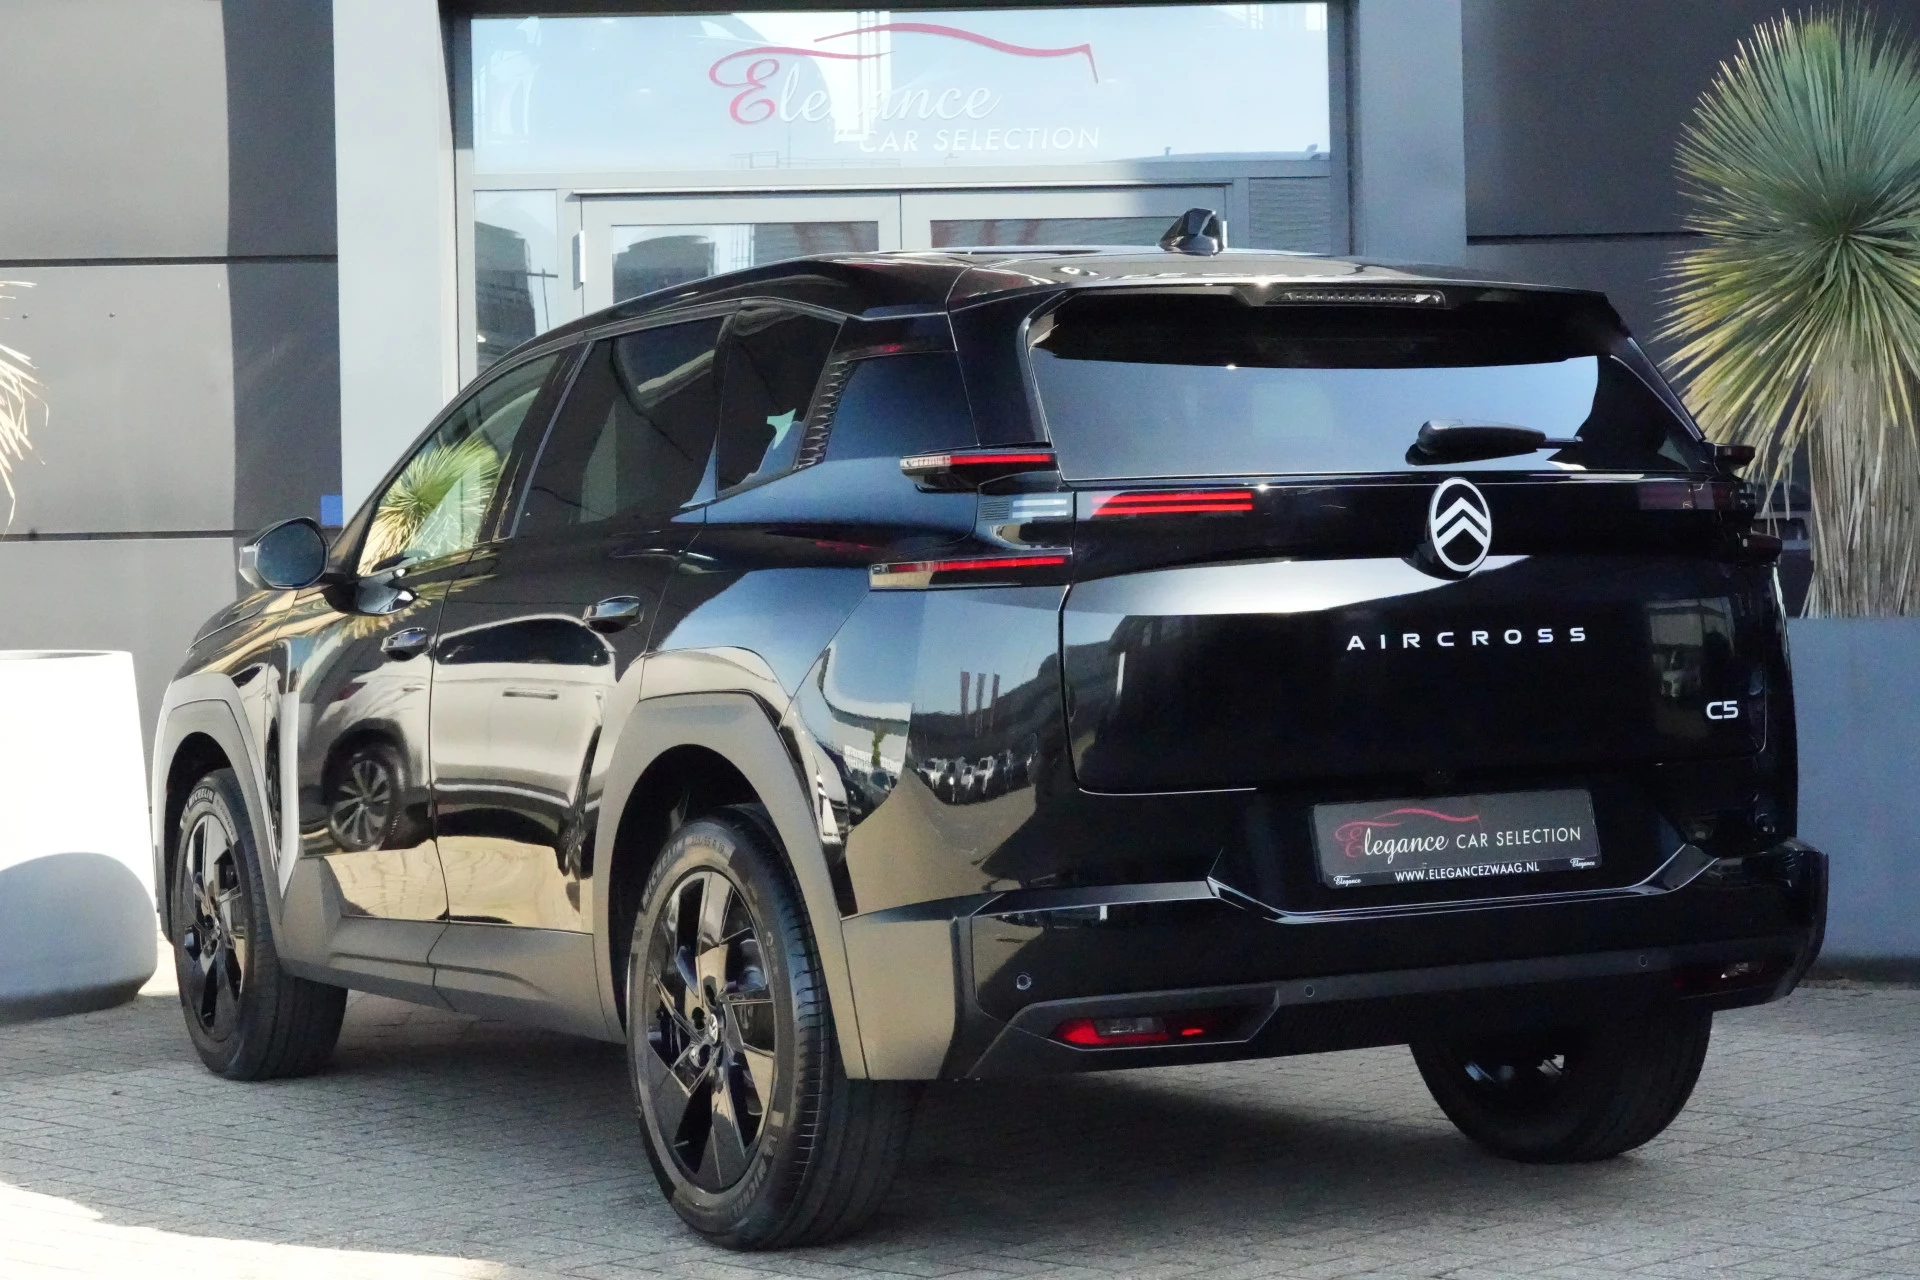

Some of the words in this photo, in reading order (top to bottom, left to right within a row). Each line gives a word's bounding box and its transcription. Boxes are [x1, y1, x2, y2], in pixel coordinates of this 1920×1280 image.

[709, 47, 1001, 140] Eleance
[859, 129, 919, 153] CAR
[935, 126, 1100, 152] SELECTION
[1346, 627, 1586, 651] AIRCROSS
[1706, 700, 1739, 720] C5
[188, 787, 214, 808] MICHELIN
[1334, 819, 1450, 864] Elegance
[1456, 833, 1488, 849] CAR
[1496, 826, 1582, 847] SELECTION
[1395, 861, 1540, 882] WWW.ELEGANCEZWAAG.NL
